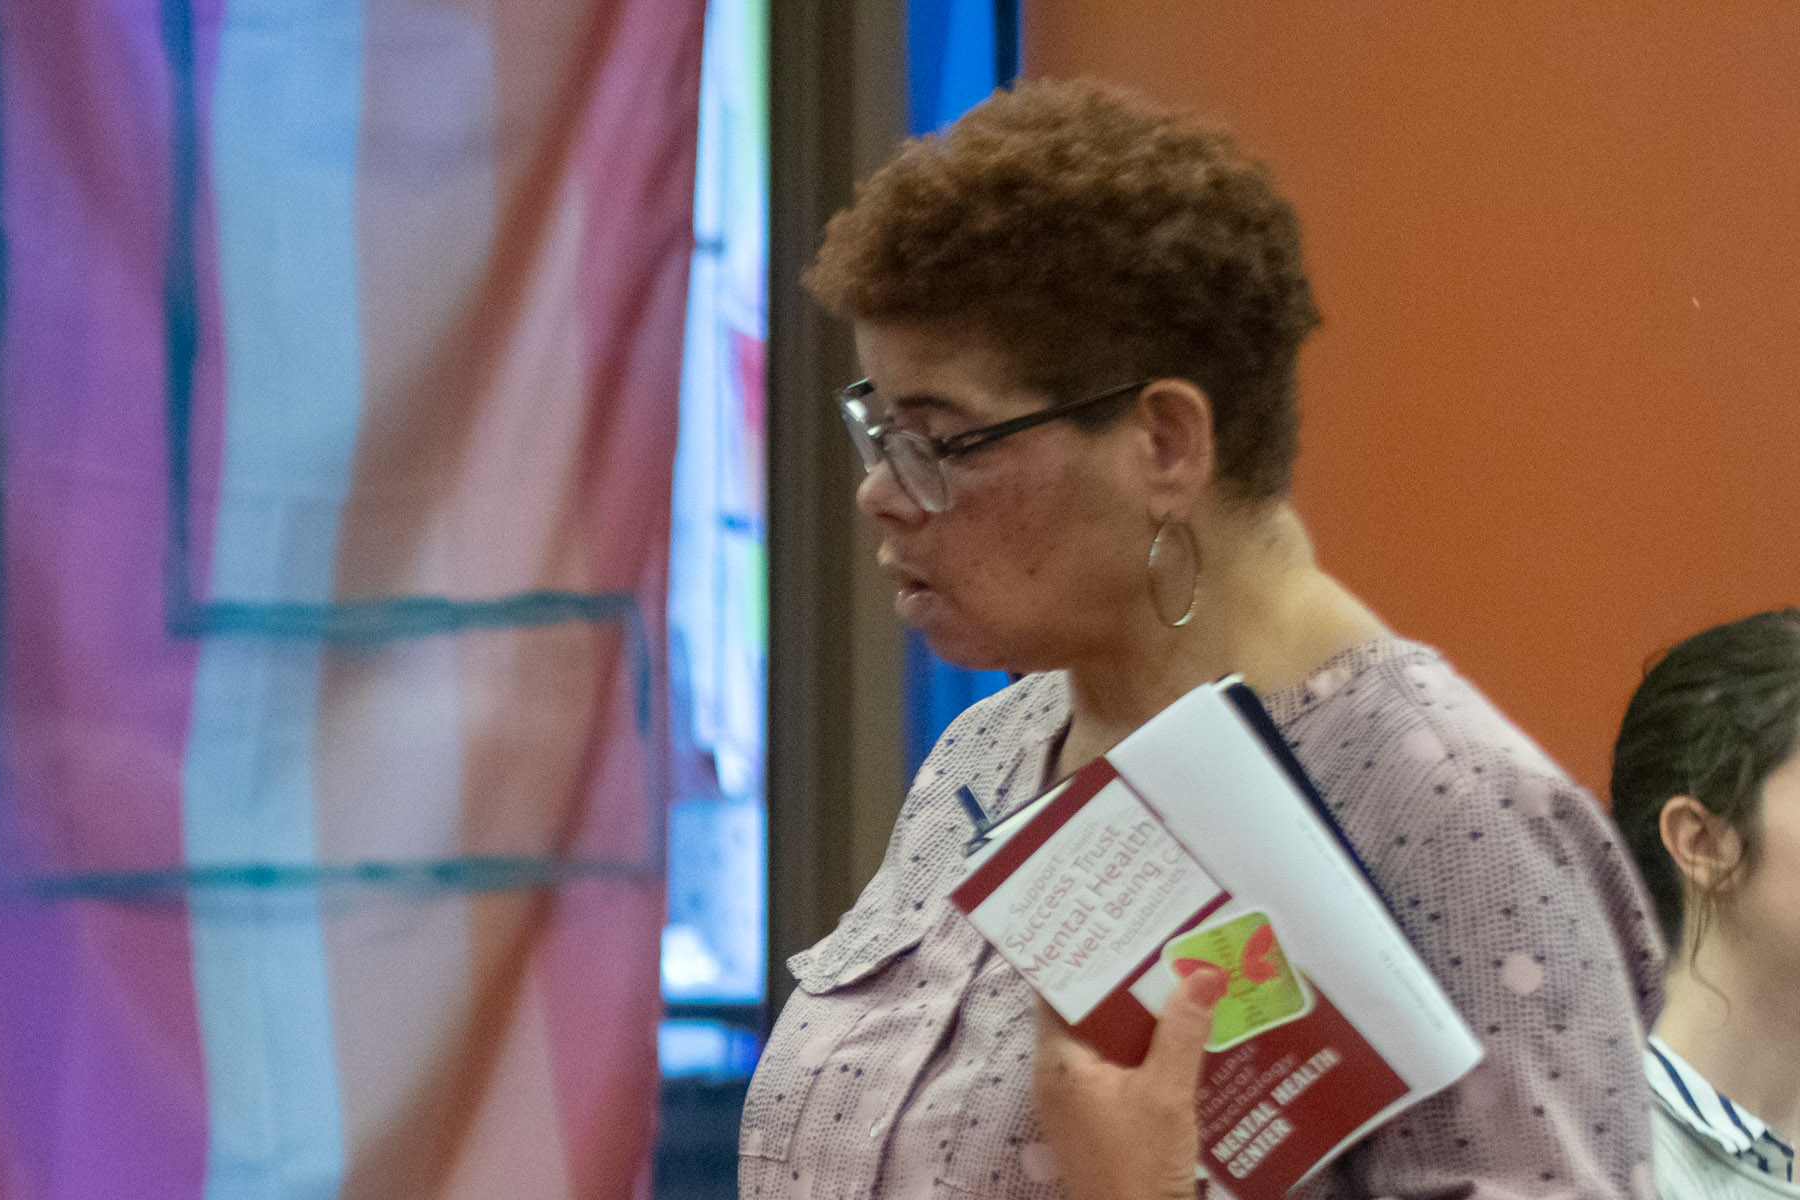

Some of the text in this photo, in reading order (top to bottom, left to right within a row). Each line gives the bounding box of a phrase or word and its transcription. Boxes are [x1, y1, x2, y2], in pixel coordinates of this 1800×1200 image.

[1006, 824, 1120, 953] Success Trust
[1009, 855, 1066, 917] Support
[1022, 819, 1157, 981] Mental Health
[1063, 922, 1110, 969] Well
[1102, 859, 1162, 921] Being
[1211, 1048, 1341, 1163] MENTAL HEALTH
[1227, 1118, 1292, 1179] CENTER
